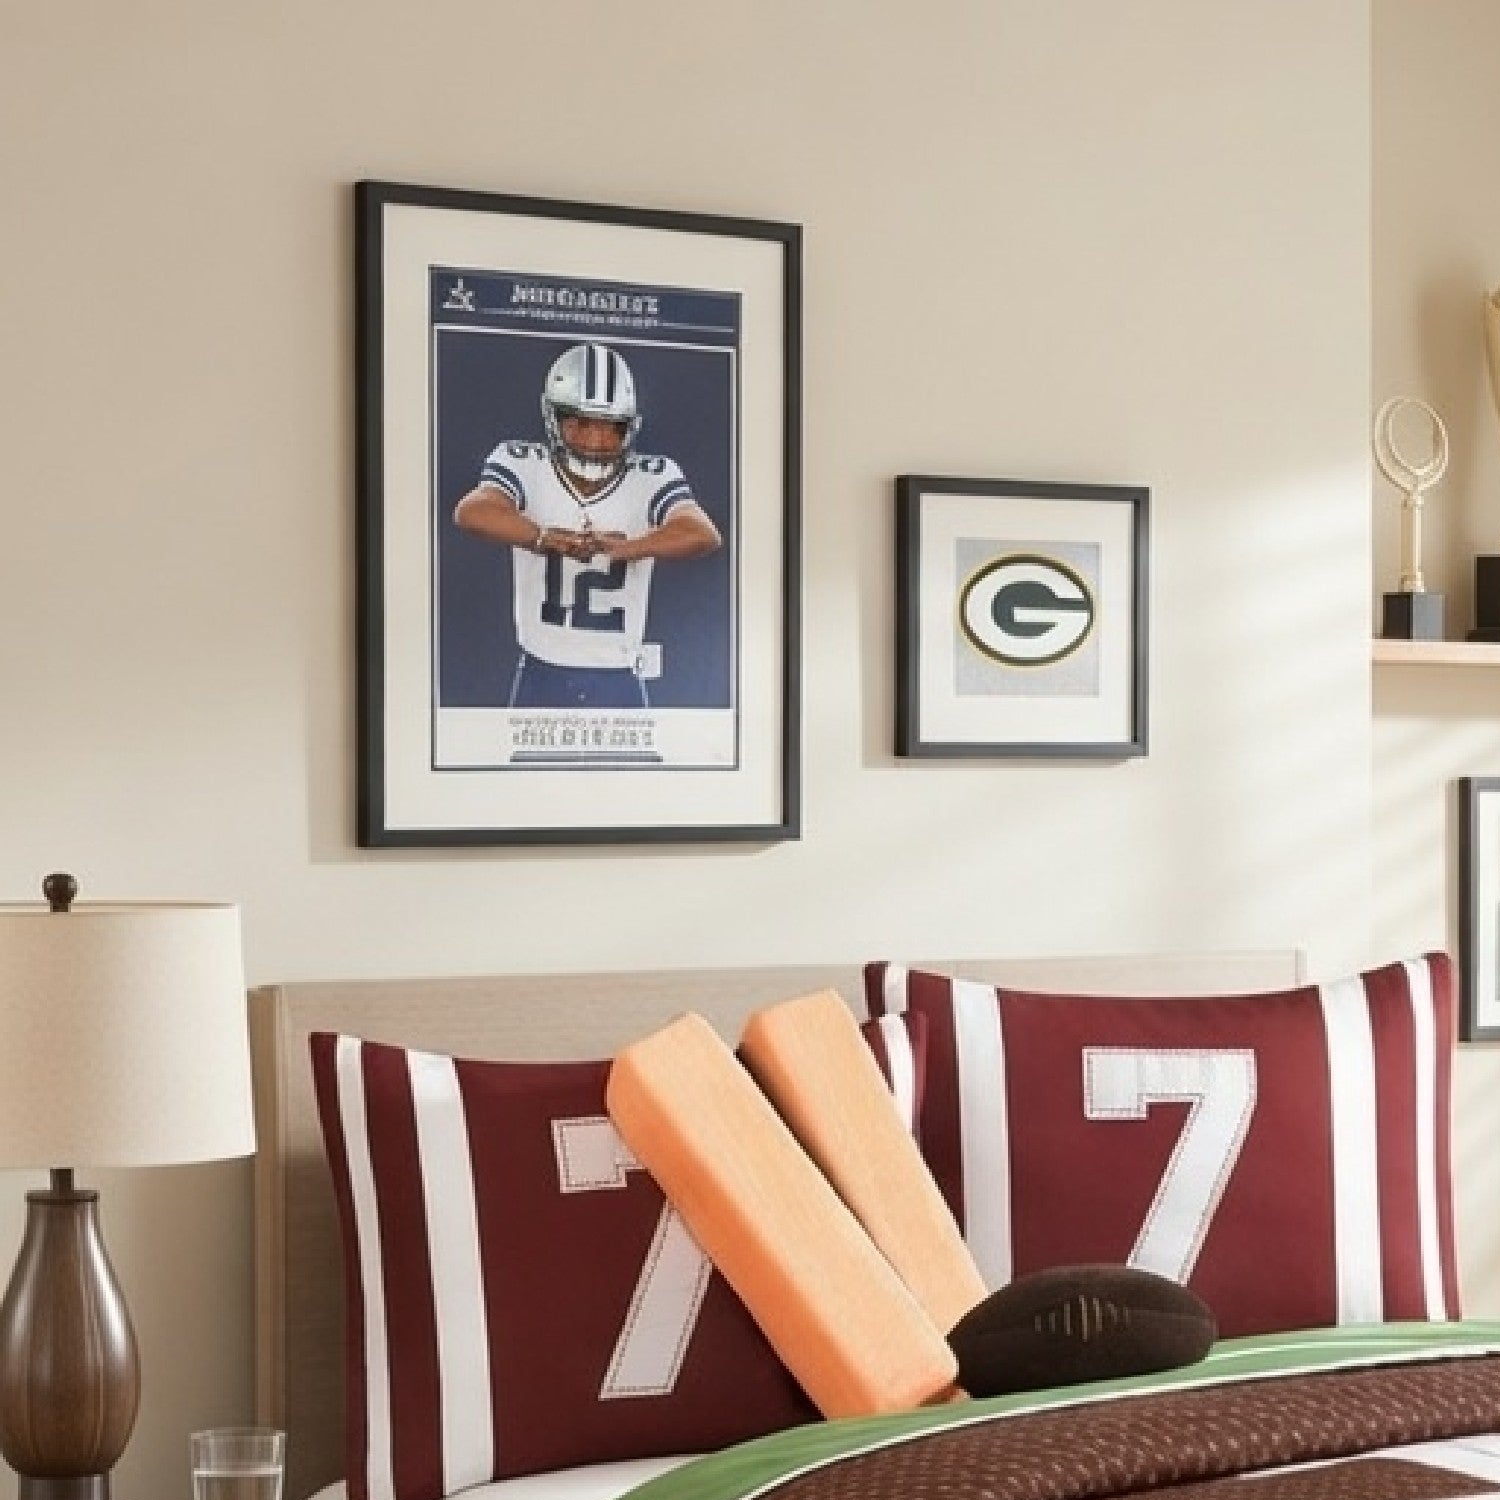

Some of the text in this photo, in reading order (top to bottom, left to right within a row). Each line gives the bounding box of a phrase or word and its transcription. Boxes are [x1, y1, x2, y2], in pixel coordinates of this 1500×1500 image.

[540, 530, 627, 634] 12
[960, 555, 1093, 666] G
[1082, 1047, 1258, 1287] 7
[551, 1116, 713, 1400] 7
